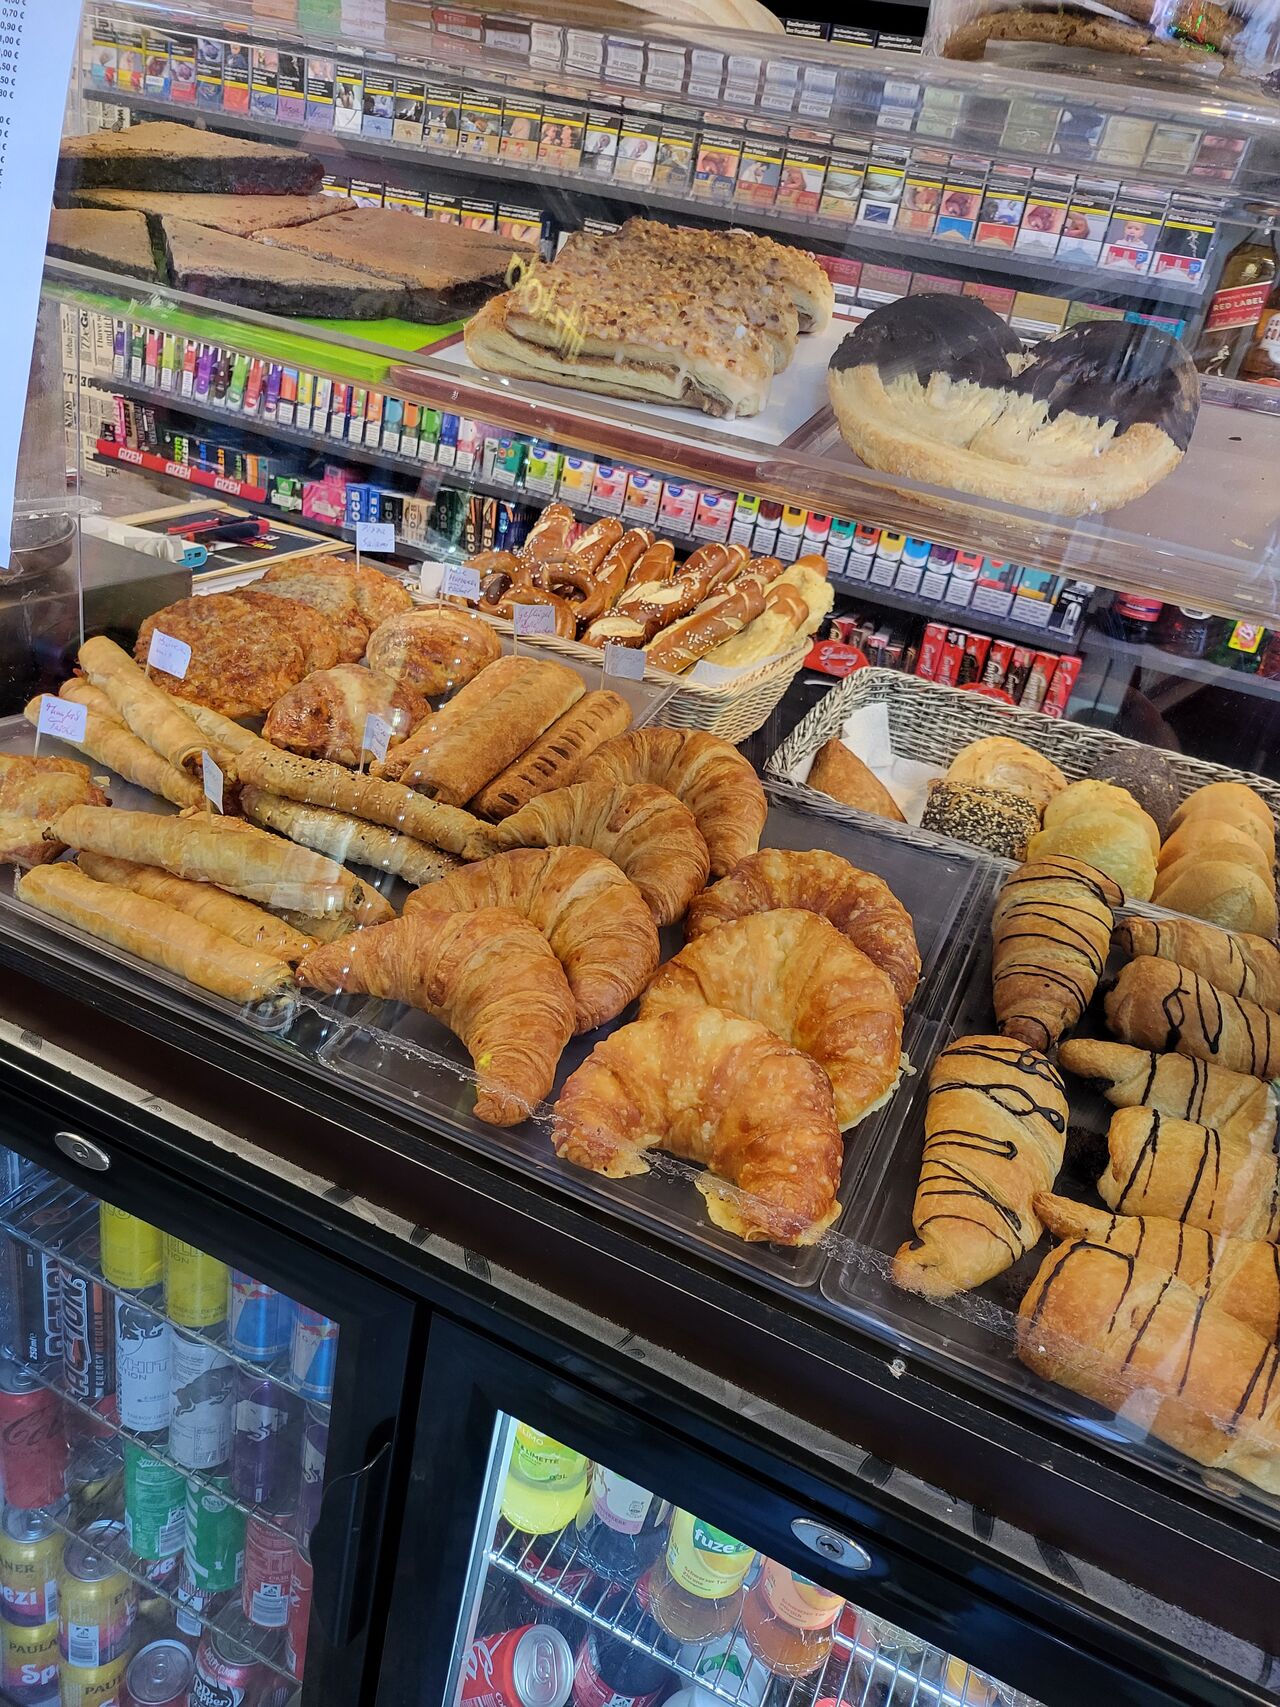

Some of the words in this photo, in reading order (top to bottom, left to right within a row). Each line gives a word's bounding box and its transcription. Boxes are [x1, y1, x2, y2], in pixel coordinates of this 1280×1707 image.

[2, 8, 18, 17] 0,70
[1213, 302, 1232, 312] RED
[1234, 296, 1265, 308] LABEL
[118, 447, 143, 465] GIZEH
[166, 462, 191, 480] GIZEH
[214, 477, 241, 496] GIZEH
[351, 491, 361, 521] OCB
[409, 504, 419, 529] OCB
[466, 524, 475, 553] OCB
[95, 1312, 105, 1354] REGULAR
[95, 1355, 105, 1387] ENERGY
[522, 1428, 544, 1446] LIMO
[525, 1447, 560, 1465] LIMETTE
[694, 1528, 735, 1554] fuze
[0, 1586, 37, 1606] ezi
[9, 1639, 58, 1655] PAULA
[21, 1663, 60, 1686] Sp
[193, 1678, 228, 1706] Pepper
